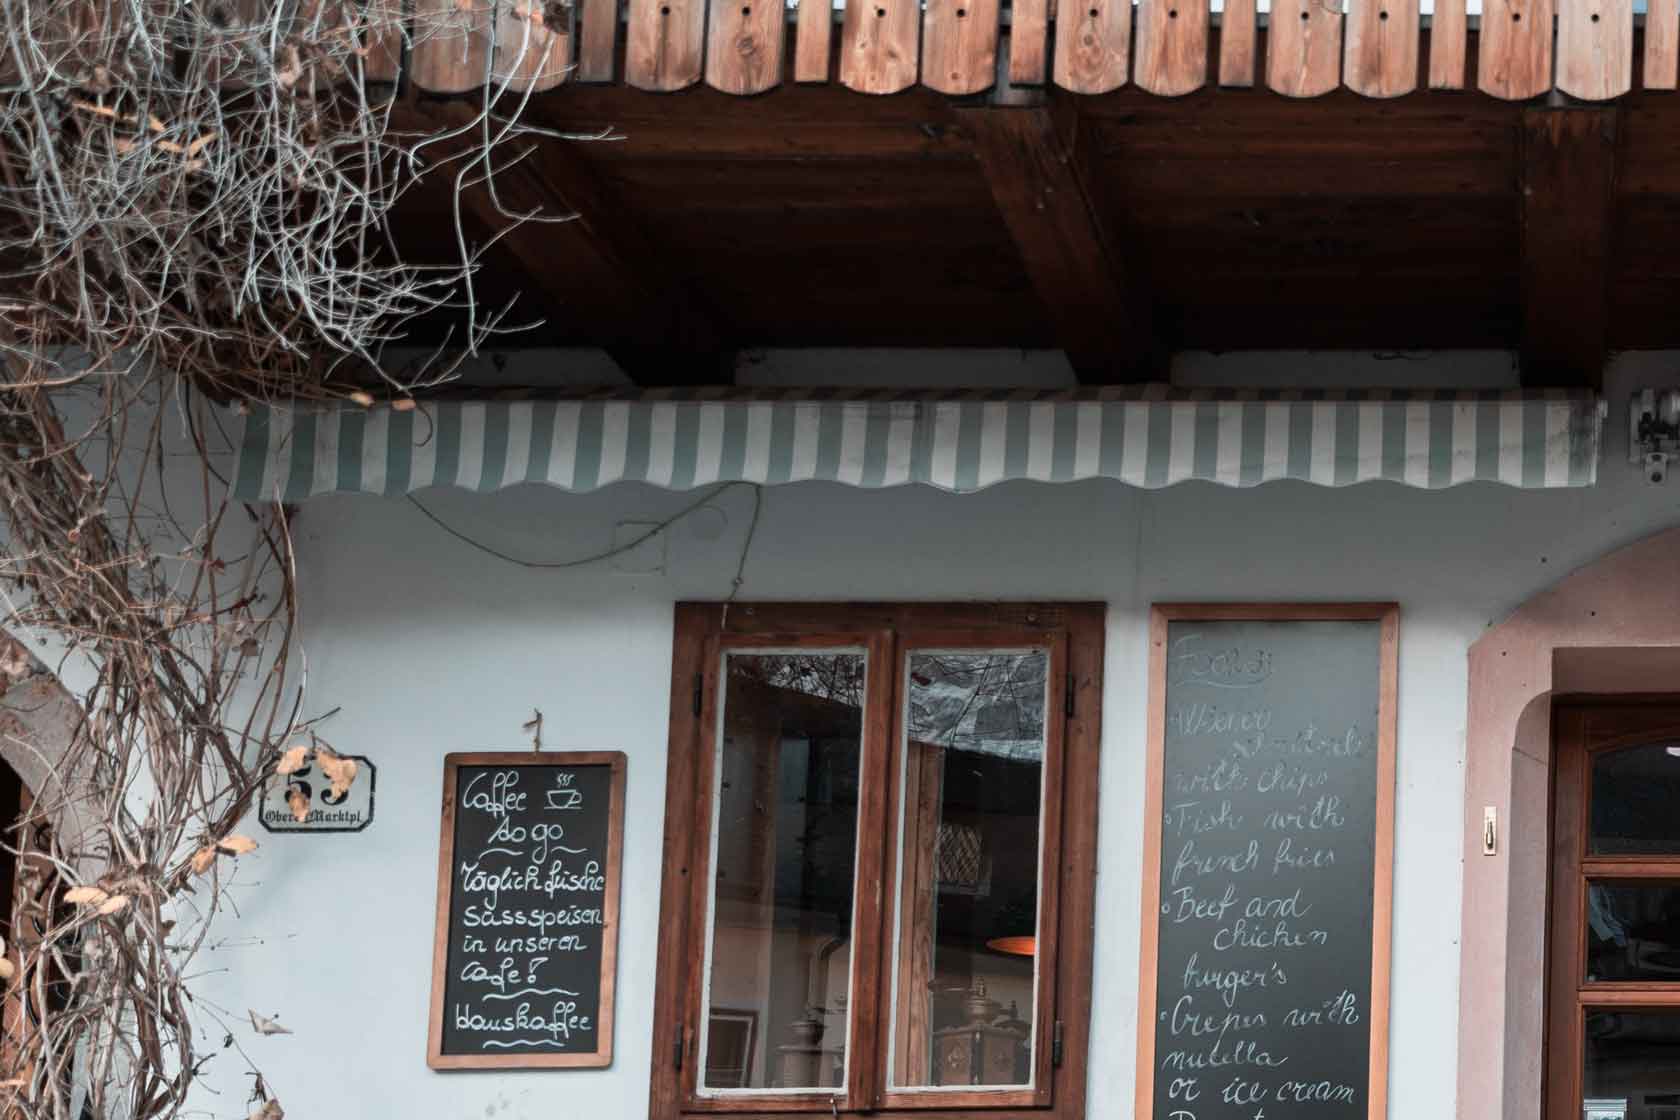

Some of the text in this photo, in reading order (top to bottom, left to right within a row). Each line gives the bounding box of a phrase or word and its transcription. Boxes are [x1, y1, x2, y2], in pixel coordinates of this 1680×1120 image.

[463, 770, 528, 818] Coffee
[531, 823, 564, 864] go
[461, 861, 543, 910] Täglich
[1172, 884, 1312, 922] Beef and
[463, 935, 588, 953] in unseren
[456, 1001, 592, 1040] Hauskaffee
[1283, 990, 1360, 1025] with
[1161, 1039, 1289, 1070] nutella
[1168, 1076, 1355, 1105] or ice cream
